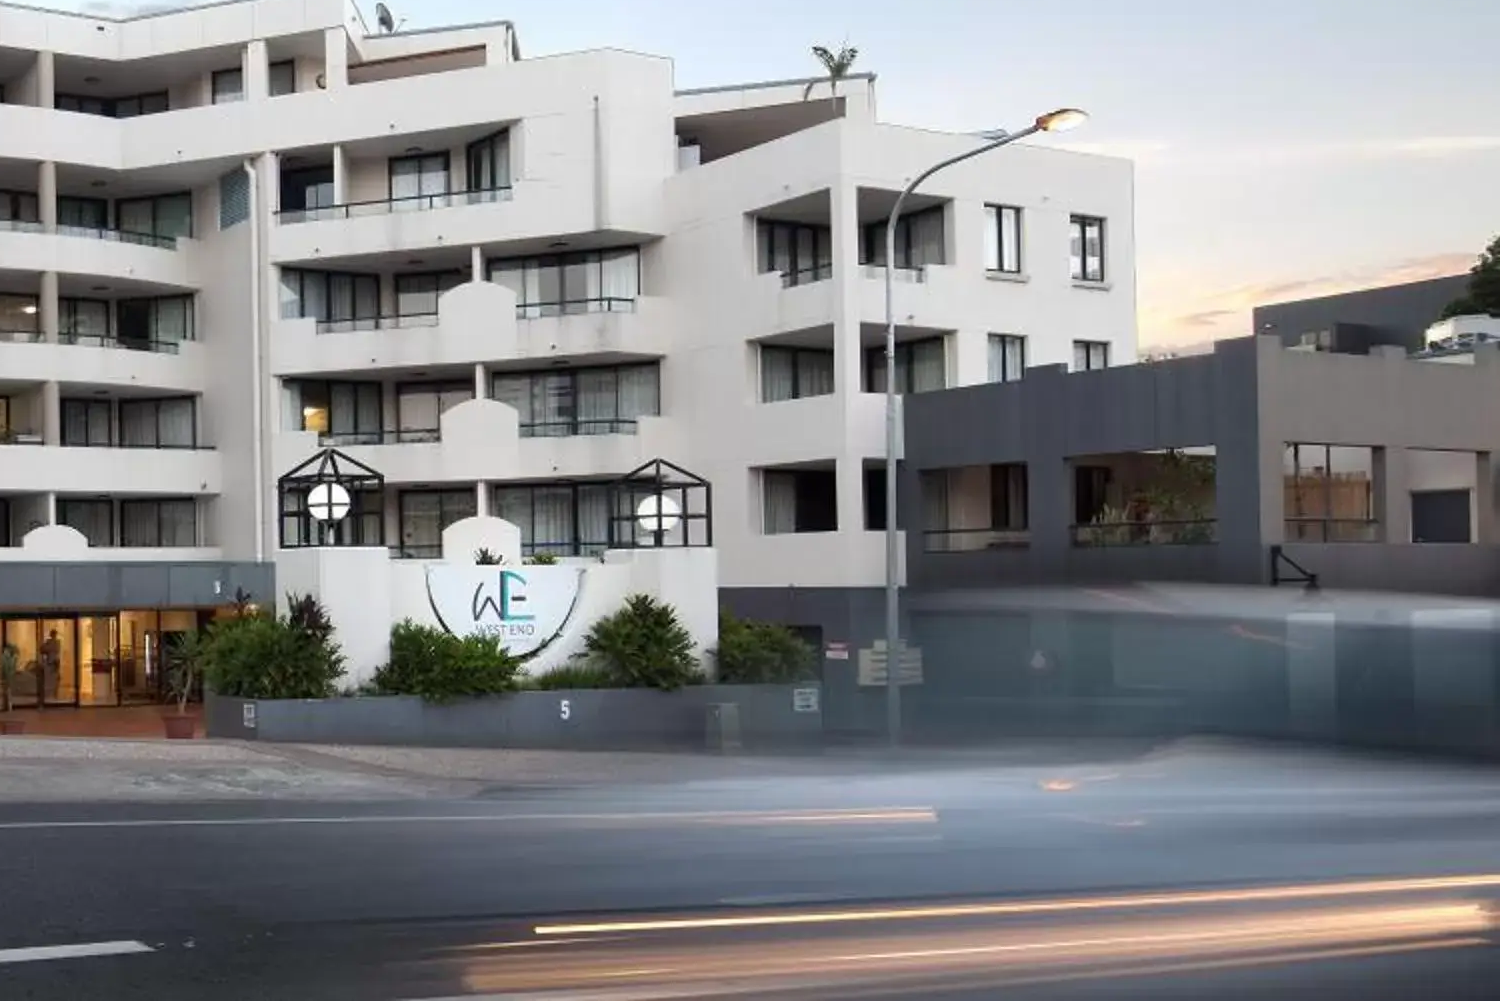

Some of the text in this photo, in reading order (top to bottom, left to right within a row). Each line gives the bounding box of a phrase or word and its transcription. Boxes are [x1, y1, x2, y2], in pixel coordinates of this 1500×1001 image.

[475, 624, 535, 635] WEST END
[560, 700, 570, 719] 5
